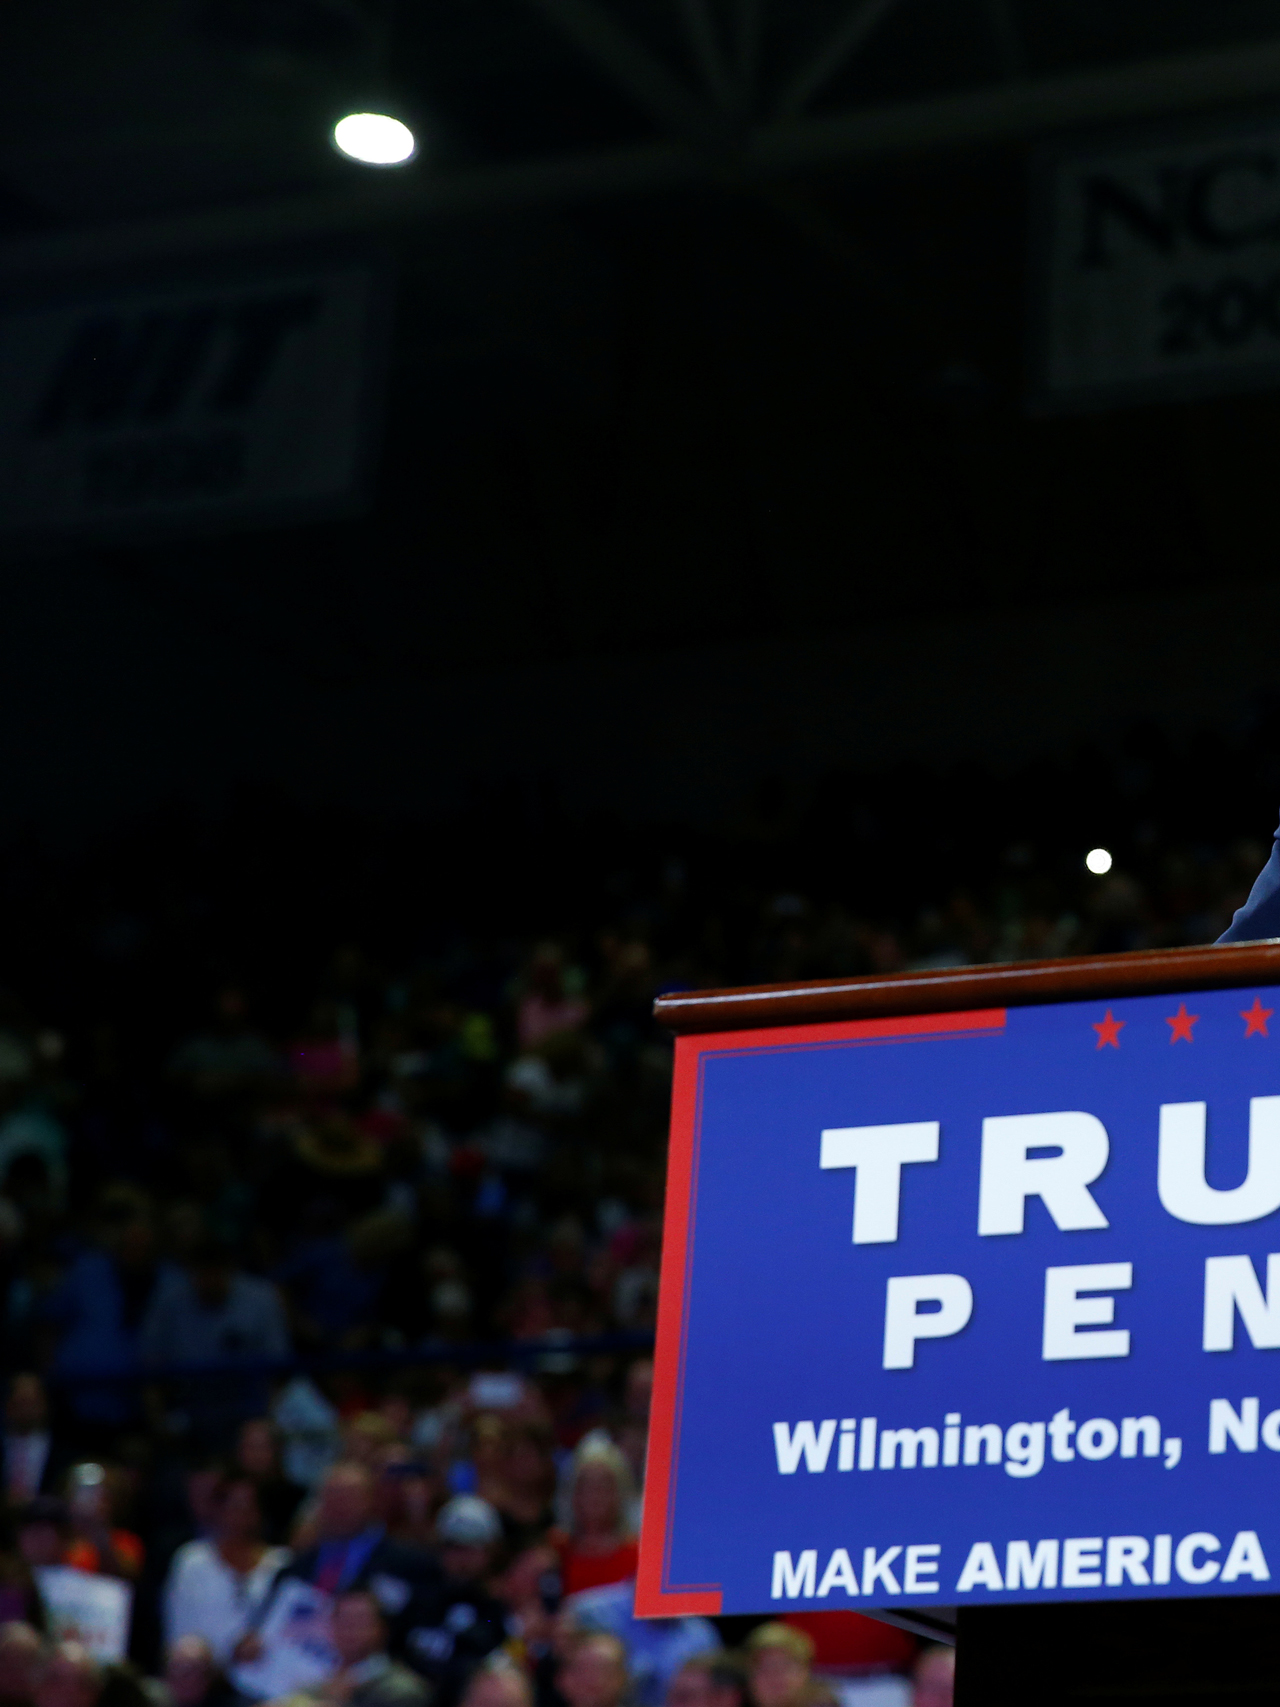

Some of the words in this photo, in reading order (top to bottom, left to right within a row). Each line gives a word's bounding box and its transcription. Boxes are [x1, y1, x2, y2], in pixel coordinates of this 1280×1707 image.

[32, 289, 321, 436] NIT
[772, 1407, 1183, 1478] Wilmington,
[770, 1543, 941, 1600] MAKE
[956, 1531, 1270, 1593] AMERICA
